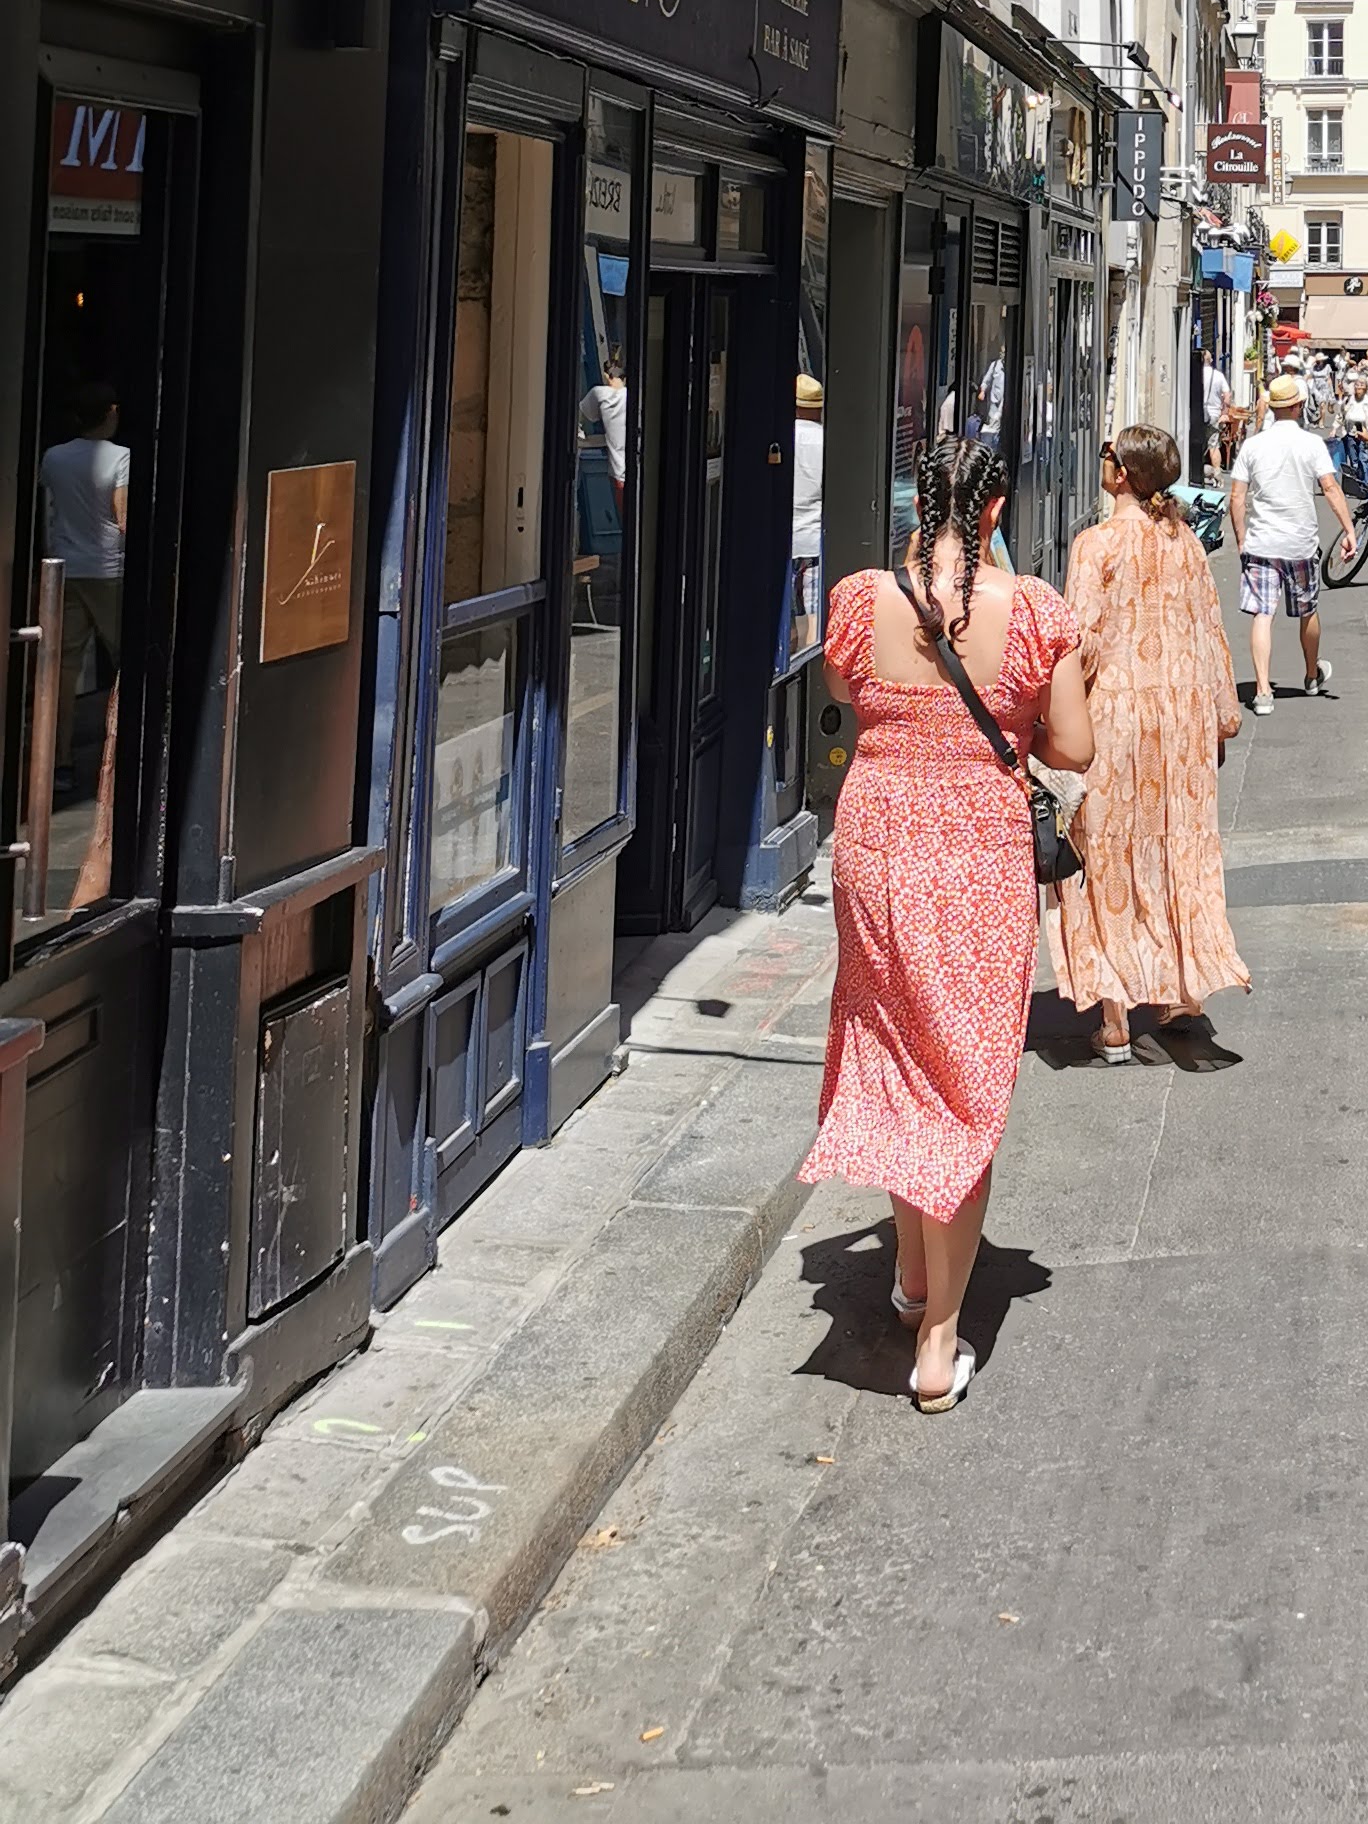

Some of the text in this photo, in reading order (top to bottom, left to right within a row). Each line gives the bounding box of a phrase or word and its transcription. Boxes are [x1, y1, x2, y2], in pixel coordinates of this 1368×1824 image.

[764, 23, 780, 58] BAR
[1132, 116, 1146, 216] IPPUDO
[1213, 160, 1259, 173] Citrouille
[1230, 149, 1243, 160] La
